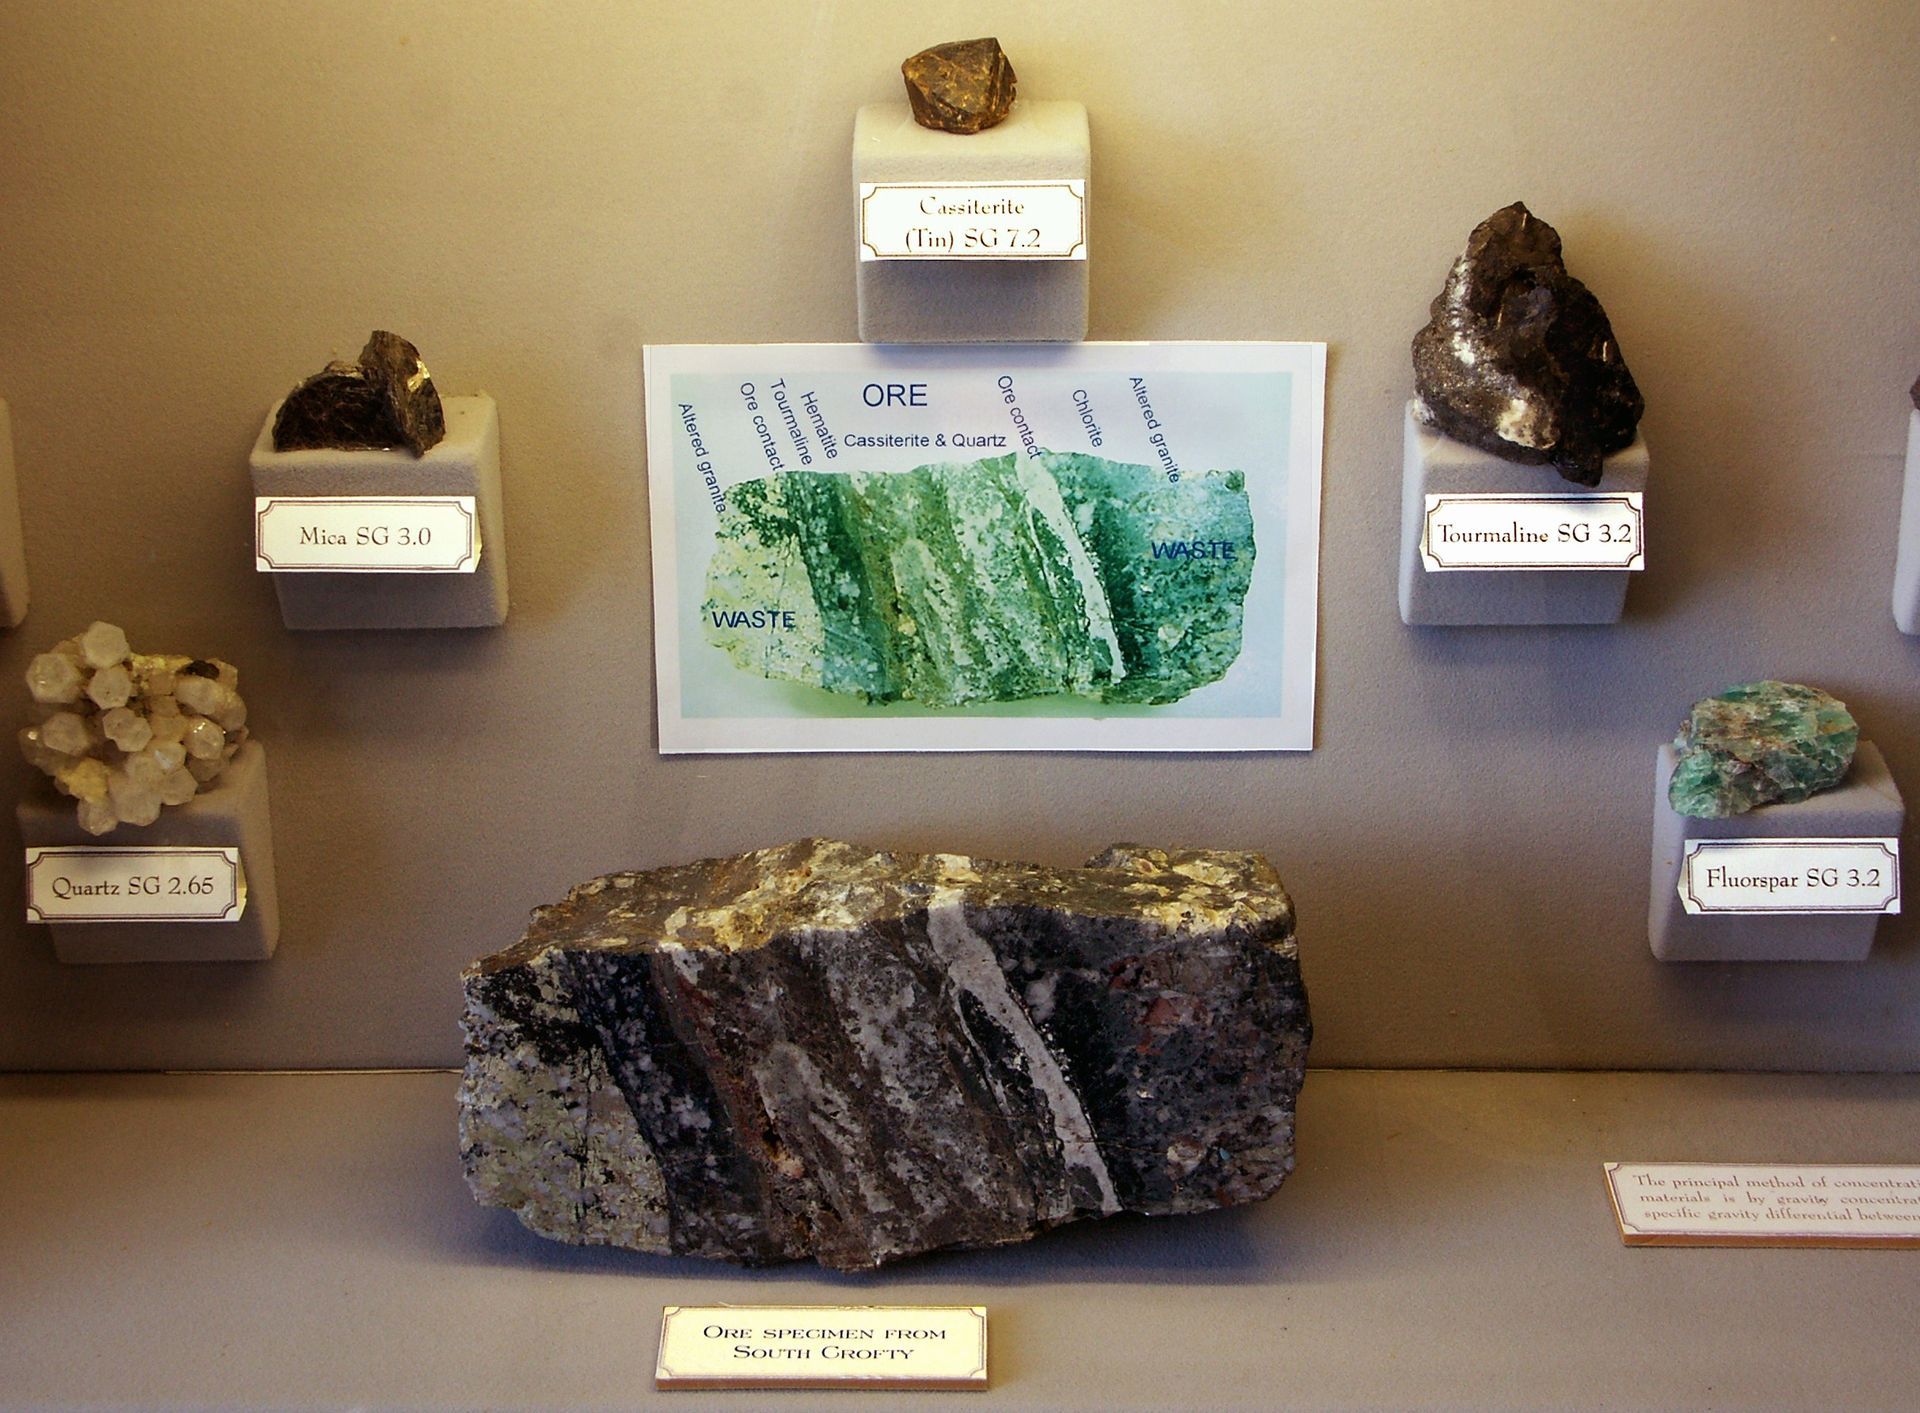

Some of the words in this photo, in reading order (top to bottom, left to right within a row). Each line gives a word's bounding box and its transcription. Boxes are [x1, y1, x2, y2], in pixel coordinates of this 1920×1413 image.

[920, 196, 1025, 215] Cassiterite
[905, 228, 954, 253] (Tin)
[964, 228, 998, 248] SG
[1007, 228, 1041, 248] 7.2
[862, 383, 928, 407] ORE
[740, 382, 758, 411] Ore
[752, 415, 785, 471] contact
[770, 378, 813, 466] Tourmaline
[800, 391, 838, 460] Hematite
[998, 375, 1016, 405] Ore
[1009, 407, 1042, 460] contact
[1072, 389, 1102, 448] Chlorite
[844, 434, 929, 448] Cassiterite
[935, 434, 946, 447] &
[951, 433, 1007, 448] Quartz
[1129, 376, 1155, 429] Altered
[1148, 432, 1180, 484] granite
[678, 402, 709, 458] Altered
[697, 461, 727, 515] granite
[299, 526, 347, 546] Mica
[356, 526, 389, 546] SG
[397, 527, 431, 546] 3.0
[1437, 521, 1549, 543] Tourmaline
[1557, 523, 1590, 543] SG
[1598, 523, 1632, 543] 3.2
[1151, 540, 1237, 560] WASTE
[712, 610, 796, 628] WASTE
[52, 876, 120, 899] Quartz
[128, 876, 161, 895] SG
[167, 876, 214, 895] 2.65
[1706, 865, 1799, 892] Fluorspar
[1806, 868, 1838, 887] SG
[1846, 868, 1880, 887] 3.2
[1633, 1174, 1666, 1187] The
[1672, 1176, 1740, 1189] principal
[1746, 1176, 1806, 1189] method
[1811, 1176, 1826, 1188] of
[1640, 1191, 1711, 1203] materials
[1723, 1193, 1736, 1203] is
[1747, 1192, 1766, 1205] by
[1777, 1194, 1829, 1207] gravity
[1645, 1207, 1701, 1220] specific
[1708, 1209, 1760, 1222] gravity
[1765, 1207, 1853, 1221] differential
